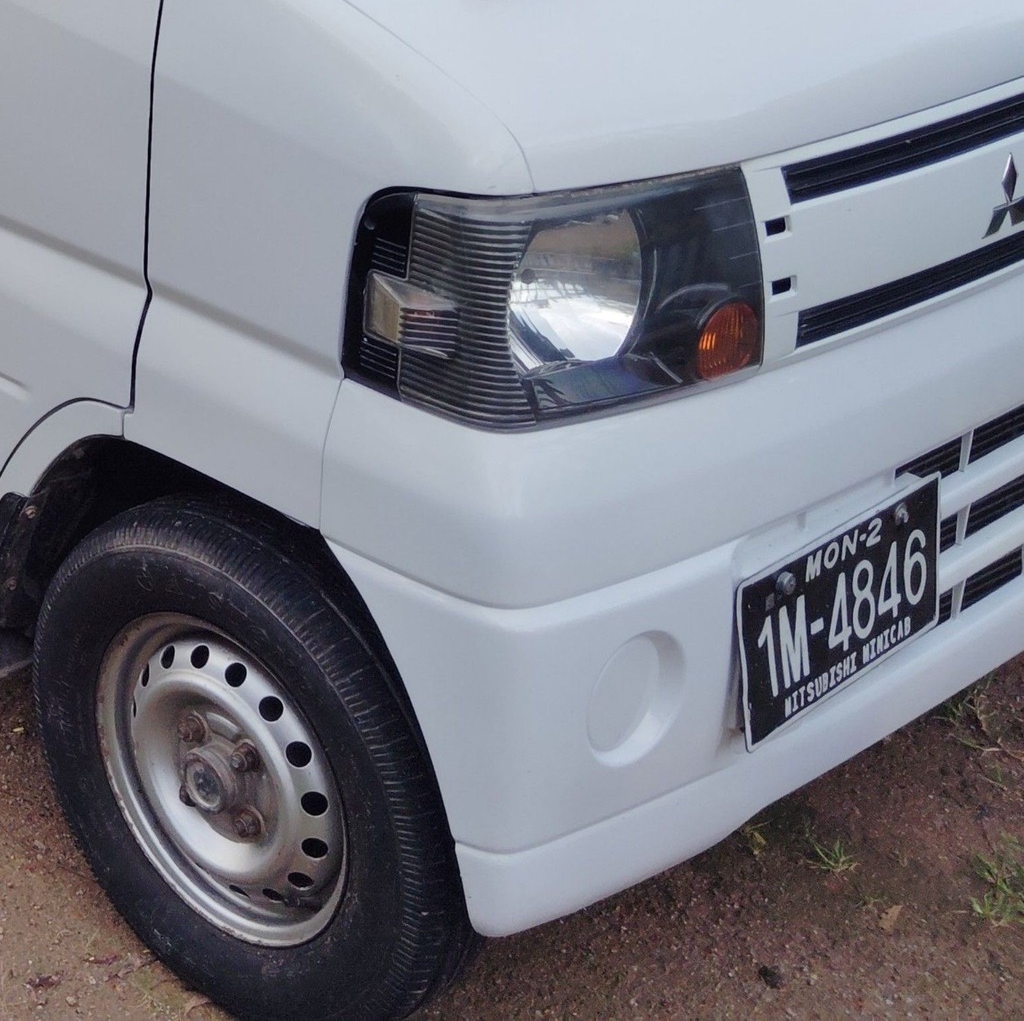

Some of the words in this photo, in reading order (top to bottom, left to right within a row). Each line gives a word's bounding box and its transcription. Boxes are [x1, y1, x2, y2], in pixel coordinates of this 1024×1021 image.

[805, 518, 882, 582] MON-2
[758, 529, 926, 697] 1M-4846
[784, 651, 857, 718] MITSUBISHI
[862, 616, 911, 664] MINICAB
